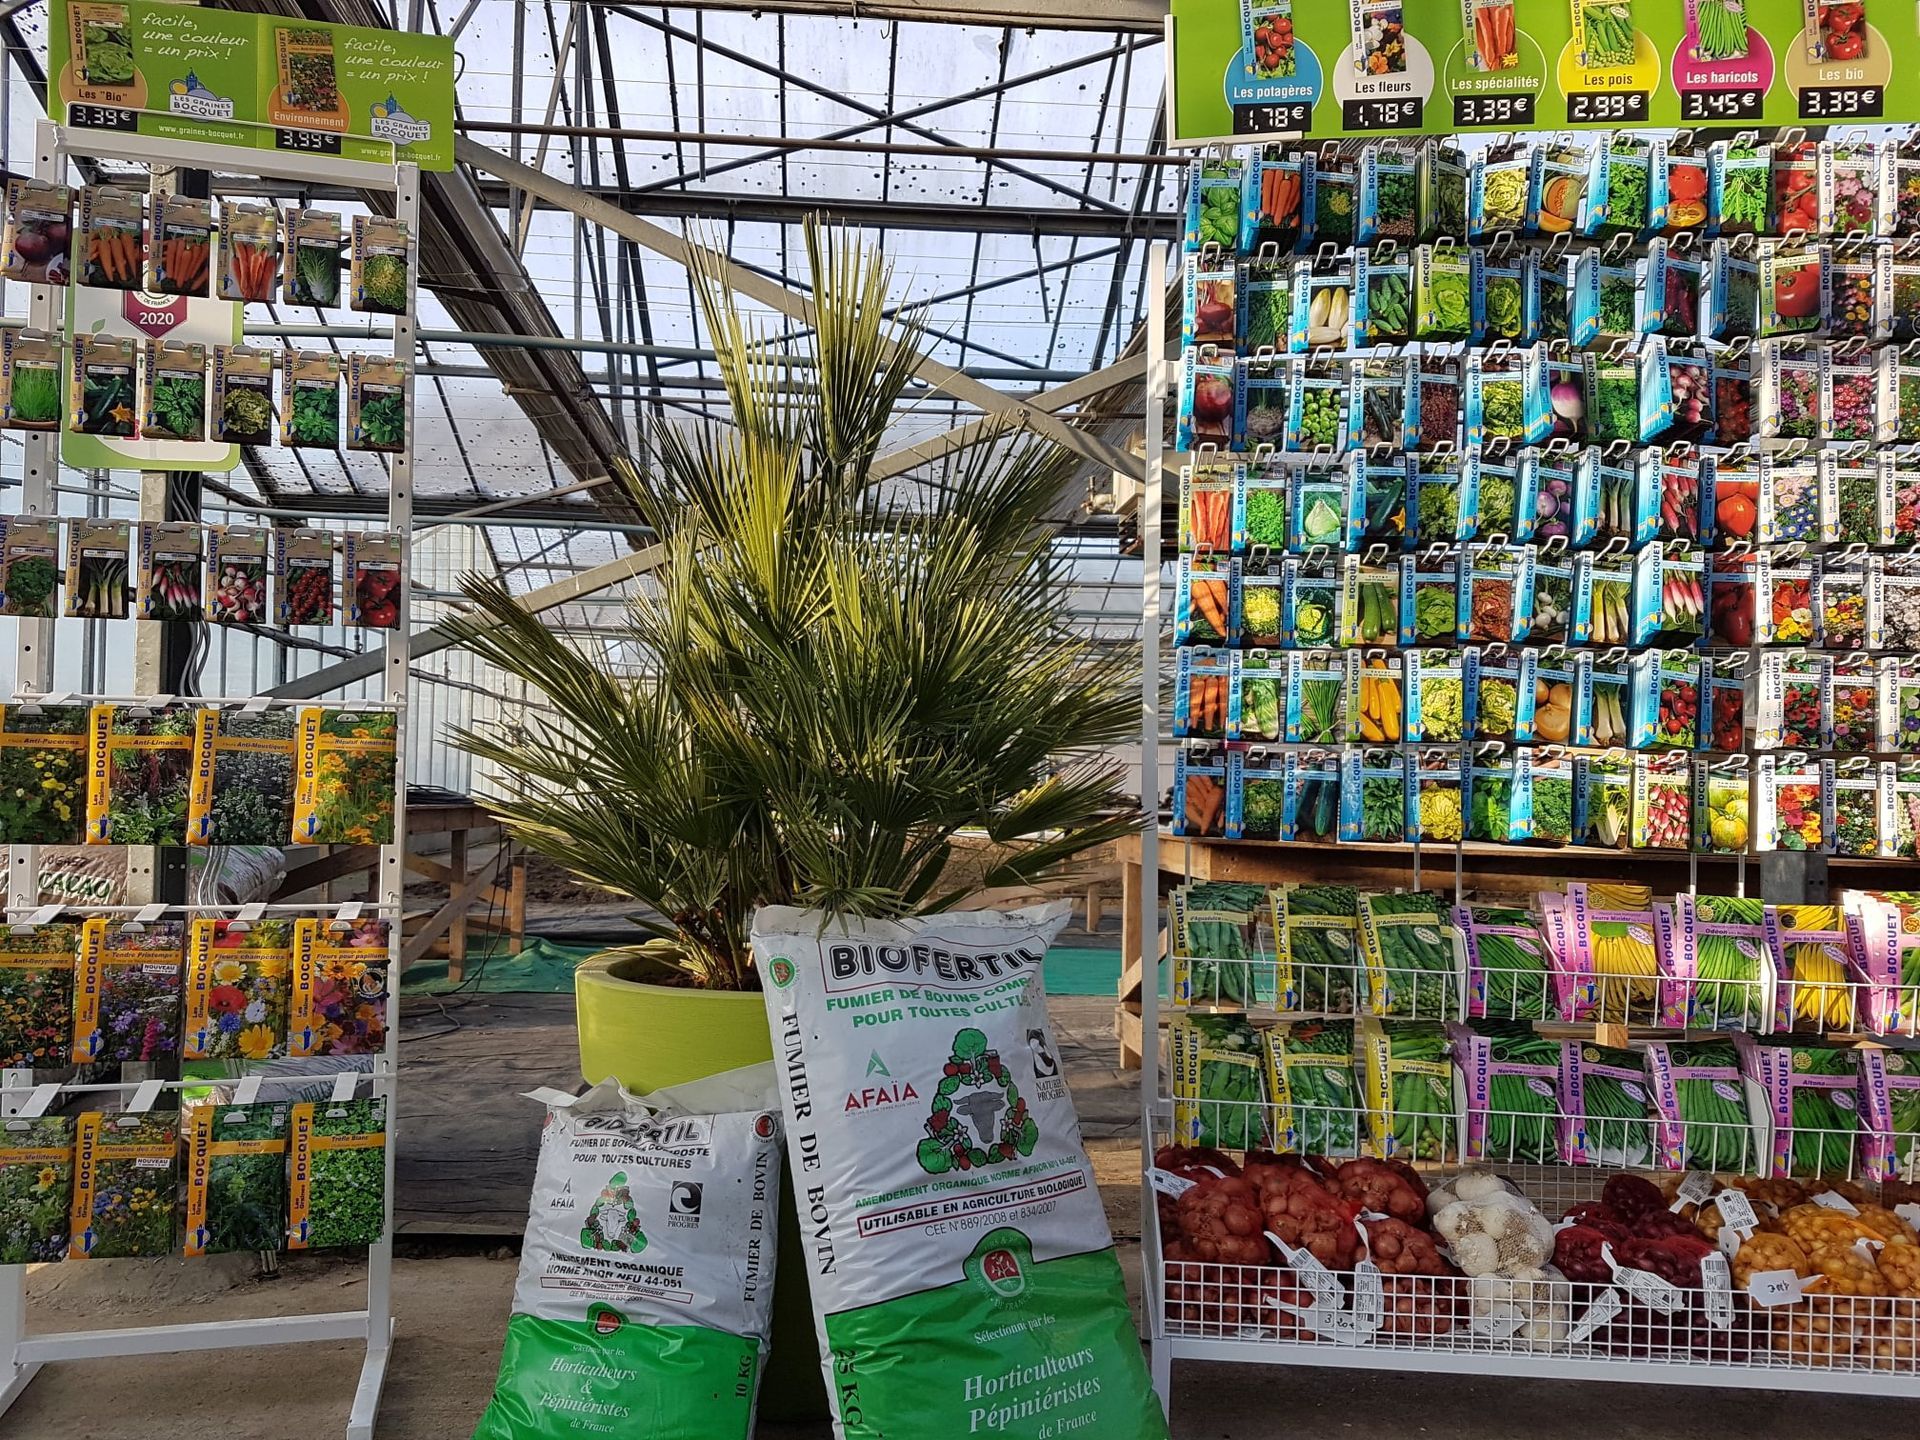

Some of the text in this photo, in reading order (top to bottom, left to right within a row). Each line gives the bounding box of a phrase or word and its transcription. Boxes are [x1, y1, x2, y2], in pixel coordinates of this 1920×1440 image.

[73, 5, 82, 44] BOCQUET
[142, 13, 198, 30] facile,
[143, 31, 248, 46] une couleur
[158, 47, 180, 56] un
[184, 46, 219, 60] prix
[344, 38, 396, 55] facile,
[345, 56, 444, 69] une couleur
[359, 71, 380, 80] un
[384, 70, 417, 84] prix
[1234, 85, 1313, 99] Les potagères
[1355, 81, 1411, 94] Les fleurs
[1452, 76, 1539, 91] Les spécialités
[1584, 74, 1633, 87] Les pois
[1686, 71, 1758, 84] Les haricots
[1820, 68, 1864, 81] Les bio
[79, 89, 127, 101] Les "Bio"
[174, 102, 231, 117] BOCQUET
[193, 99, 231, 109] GRAINES
[159, 124, 244, 140] www.graines-bocquet.fr
[274, 112, 344, 127] Environnement
[375, 125, 428, 139] BOCQUET
[392, 121, 428, 131] GRAINES
[140, 312, 174, 325] 2020
[96, 714, 108, 777] BOCQUET
[201, 715, 214, 777] BOCQUET
[305, 718, 316, 777] BOCQUET
[1177, 893, 1187, 949] BOCQUET
[1359, 899, 1377, 954] BOCQUET
[1575, 889, 1587, 948] BOCQUET
[1684, 901, 1693, 961] BOCQUET
[1660, 910, 1675, 967] BOCQUET
[1887, 914, 1897, 975] BOCQUET
[86, 929, 100, 994] BOCQUET
[196, 926, 210, 990] BOCQUET
[300, 927, 313, 991] BOCQUET
[829, 943, 1043, 982] BIOFERTIL
[826, 989, 895, 1012] FUMIER
[900, 989, 921, 1000] DE
[925, 989, 980, 1003] BOVINS
[852, 1006, 971, 1028] POUR TOUTES
[1176, 1027, 1186, 1082] BOCQUET
[1188, 1030, 1198, 1084] BOCQUET
[1271, 1035, 1286, 1094] BOCQUET
[1378, 1039, 1388, 1098] BOCQUET
[1477, 1043, 1487, 1100] BOCQUET
[1570, 1043, 1580, 1097] BOCQUET
[845, 1080, 919, 1112] AFAÏA
[1656, 1049, 1675, 1108] BOCQUET
[1779, 1053, 1789, 1114] BOCQUET
[1871, 1054, 1887, 1115] BOCQUET
[80, 1124, 94, 1189] BOCQUET
[195, 1122, 208, 1187] BOCQUET
[297, 1116, 309, 1181] BOCQUET
[599, 1138, 610, 1146] DE
[782, 1012, 837, 1277] FUMIER DE BOVIN
[573, 1154, 692, 1169] POUR TOUTES CULTURES
[855, 1184, 929, 1208] AMENDEMENT
[931, 1175, 990, 1192] ORGANIQUE
[990, 1168, 1020, 1181] NORME
[863, 1175, 1083, 1231] UTILISABLE EN AGRICULTURE BIOLOGIQUE
[743, 1151, 768, 1302] FUMIER DE BOVIN
[925, 1223, 947, 1237] CEE
[1009, 1211, 1019, 1221] et
[1020, 1201, 1057, 1219] 834/2007
[614, 1261, 684, 1277] ORGANIQUE
[644, 1276, 682, 1288] 44-051
[1027, 1317, 1041, 1331] par
[1043, 1313, 1055, 1325] les
[549, 1357, 638, 1382] Horticulteurs
[580, 1379, 593, 1395] &
[735, 1355, 753, 1399] 10 KG
[962, 1345, 1095, 1402] Horticulteurs
[538, 1392, 631, 1419] Pépiniéristes
[838, 1382, 864, 1427] KG
[968, 1374, 1102, 1433] Pépiniéristes
[570, 1417, 615, 1434] de France
[1038, 1409, 1098, 1440] de France
